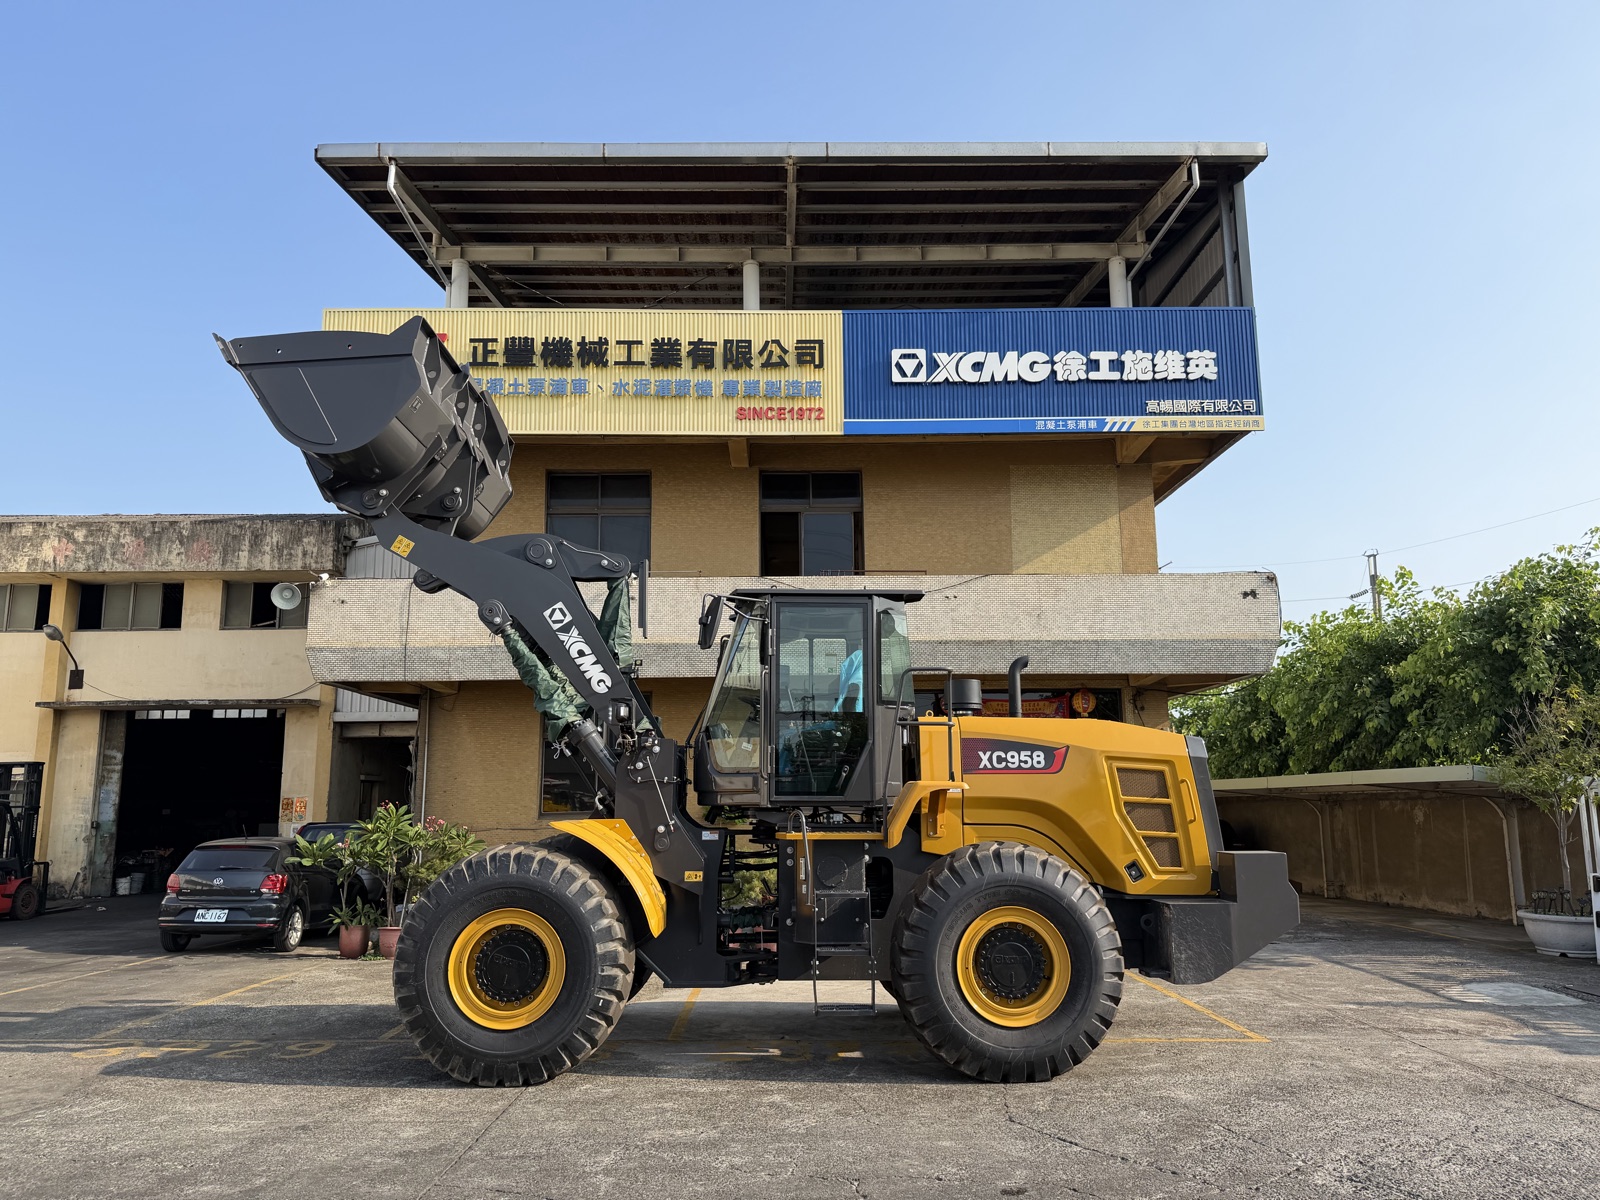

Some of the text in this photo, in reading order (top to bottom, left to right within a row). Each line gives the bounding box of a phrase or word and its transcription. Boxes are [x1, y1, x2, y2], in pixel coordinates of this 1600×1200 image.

[469, 336, 825, 369] 正豐機械工業有限公司
[927, 349, 1218, 384] XCMG 徐工施维英
[721, 379, 823, 398] 專業製造廠
[736, 406, 825, 421] SINCE1972
[1145, 399, 1257, 414] 高暢國際有限公司
[1035, 420, 1098, 430] 混凝土泵浦車
[1142, 419, 1261, 429] 徐工集團台灣地區指定經銷商
[555, 625, 612, 694] XCMG
[977, 750, 1046, 769] XC958
